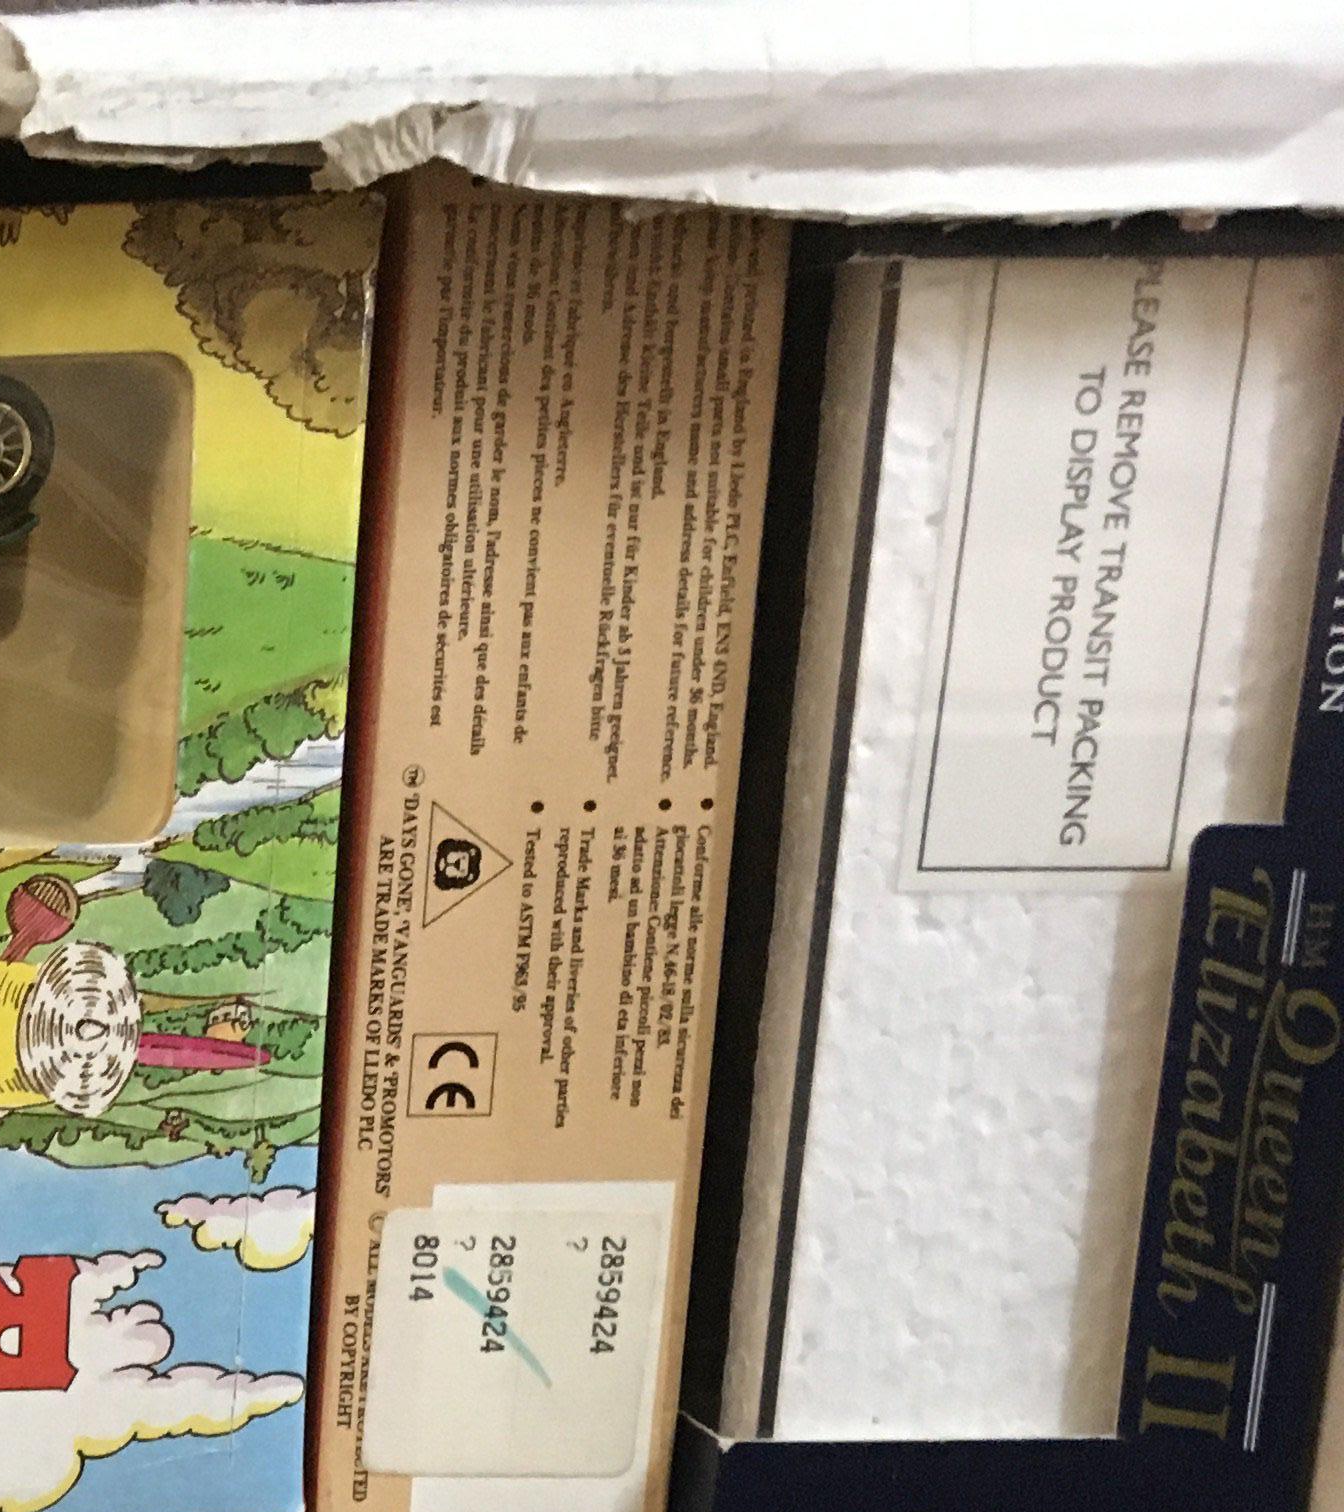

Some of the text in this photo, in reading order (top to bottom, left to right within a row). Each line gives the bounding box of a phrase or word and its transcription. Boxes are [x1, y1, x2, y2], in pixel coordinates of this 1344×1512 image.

[1103, 389, 1146, 529] REMOVE
[1032, 365, 1107, 745] TO DISPLAY PRODUCT
[1083, 543, 1126, 685] TRANSIT
[1059, 698, 1104, 845] PACKING
[357, 835, 395, 1150] ARE TRADE MARKS OF LLEDO PLC
[1155, 868, 1275, 1316] Elizabeth
[407, 1234, 438, 1302] 8014
[479, 1236, 516, 1354] 2859424
[589, 1236, 626, 1355] 2859424
[336, 1294, 361, 1429] BY COPYRIGHT
[1138, 1345, 1237, 1442] II
